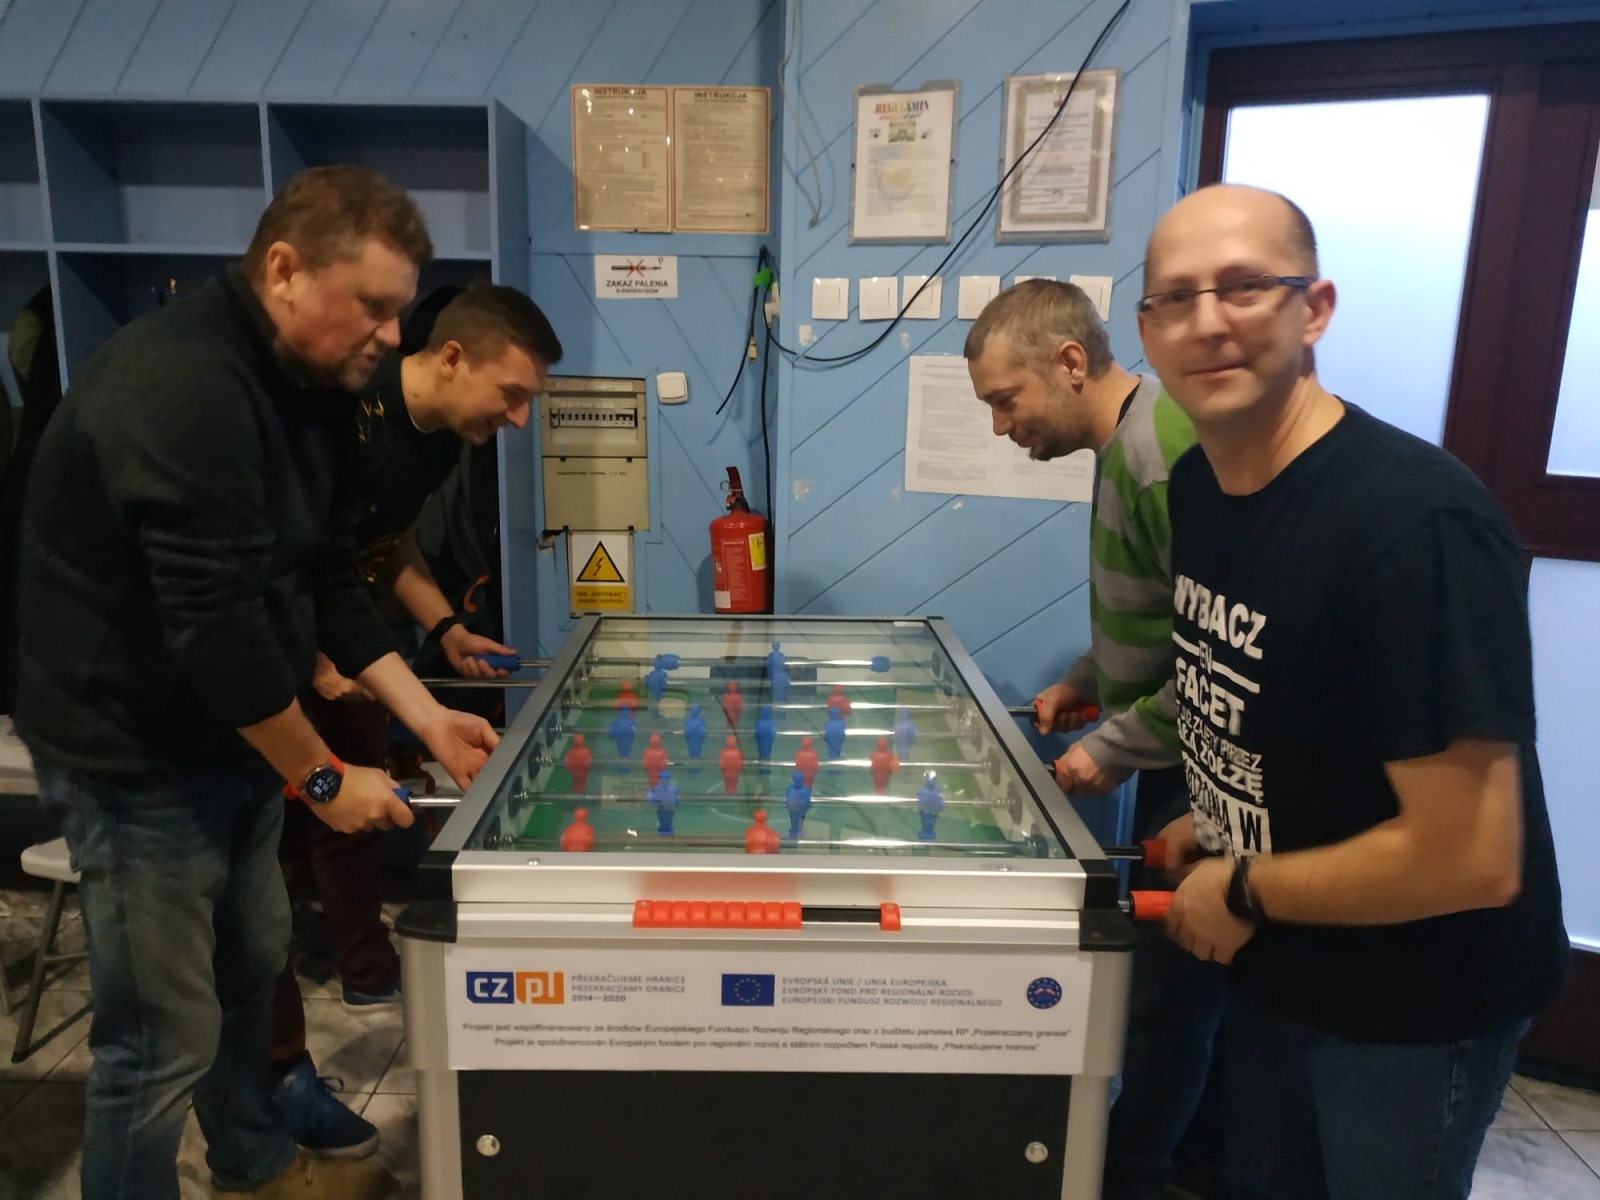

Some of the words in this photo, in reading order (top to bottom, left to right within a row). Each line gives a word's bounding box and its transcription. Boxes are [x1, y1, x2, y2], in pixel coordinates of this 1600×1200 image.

[1174, 574, 1267, 661] WYBACZ
[1175, 656, 1245, 737] FACET
[1239, 806, 1263, 854] W
[646, 976, 686, 984] HRANICE
[833, 977, 854, 985] UNIE
[890, 979, 948, 987] EUROPEJSKA
[571, 985, 643, 993] PRZEKRACZAMY
[645, 985, 686, 993] GRANICE
[831, 987, 857, 995] FOND
[860, 987, 878, 995] PRO
[939, 988, 974, 996] ROZVOJ
[782, 996, 836, 1004] EUROPEJSKI
[838, 997, 881, 1005] FUNDUSZ
[883, 998, 928, 1006] ROZWOJU
[930, 998, 1003, 1007] REGIONALNEGO
[463, 1023, 494, 1032] Projekt
[495, 1023, 512, 1032] jest
[645, 1024, 706, 1034] Europejskiego
[708, 1025, 751, 1034] Funduszu
[753, 1026, 790, 1035] Rozwoju
[792, 1026, 851, 1036] Regionalnego
[955, 1028, 970, 1036] RP
[494, 1038, 525, 1047] Projekt
[527, 1039, 535, 1048] je
[659, 1039, 692, 1047] fondem
[693, 1041, 709, 1049] pro
[754, 1041, 780, 1050] rozvoj
[901, 1042, 939, 1052] republiky
